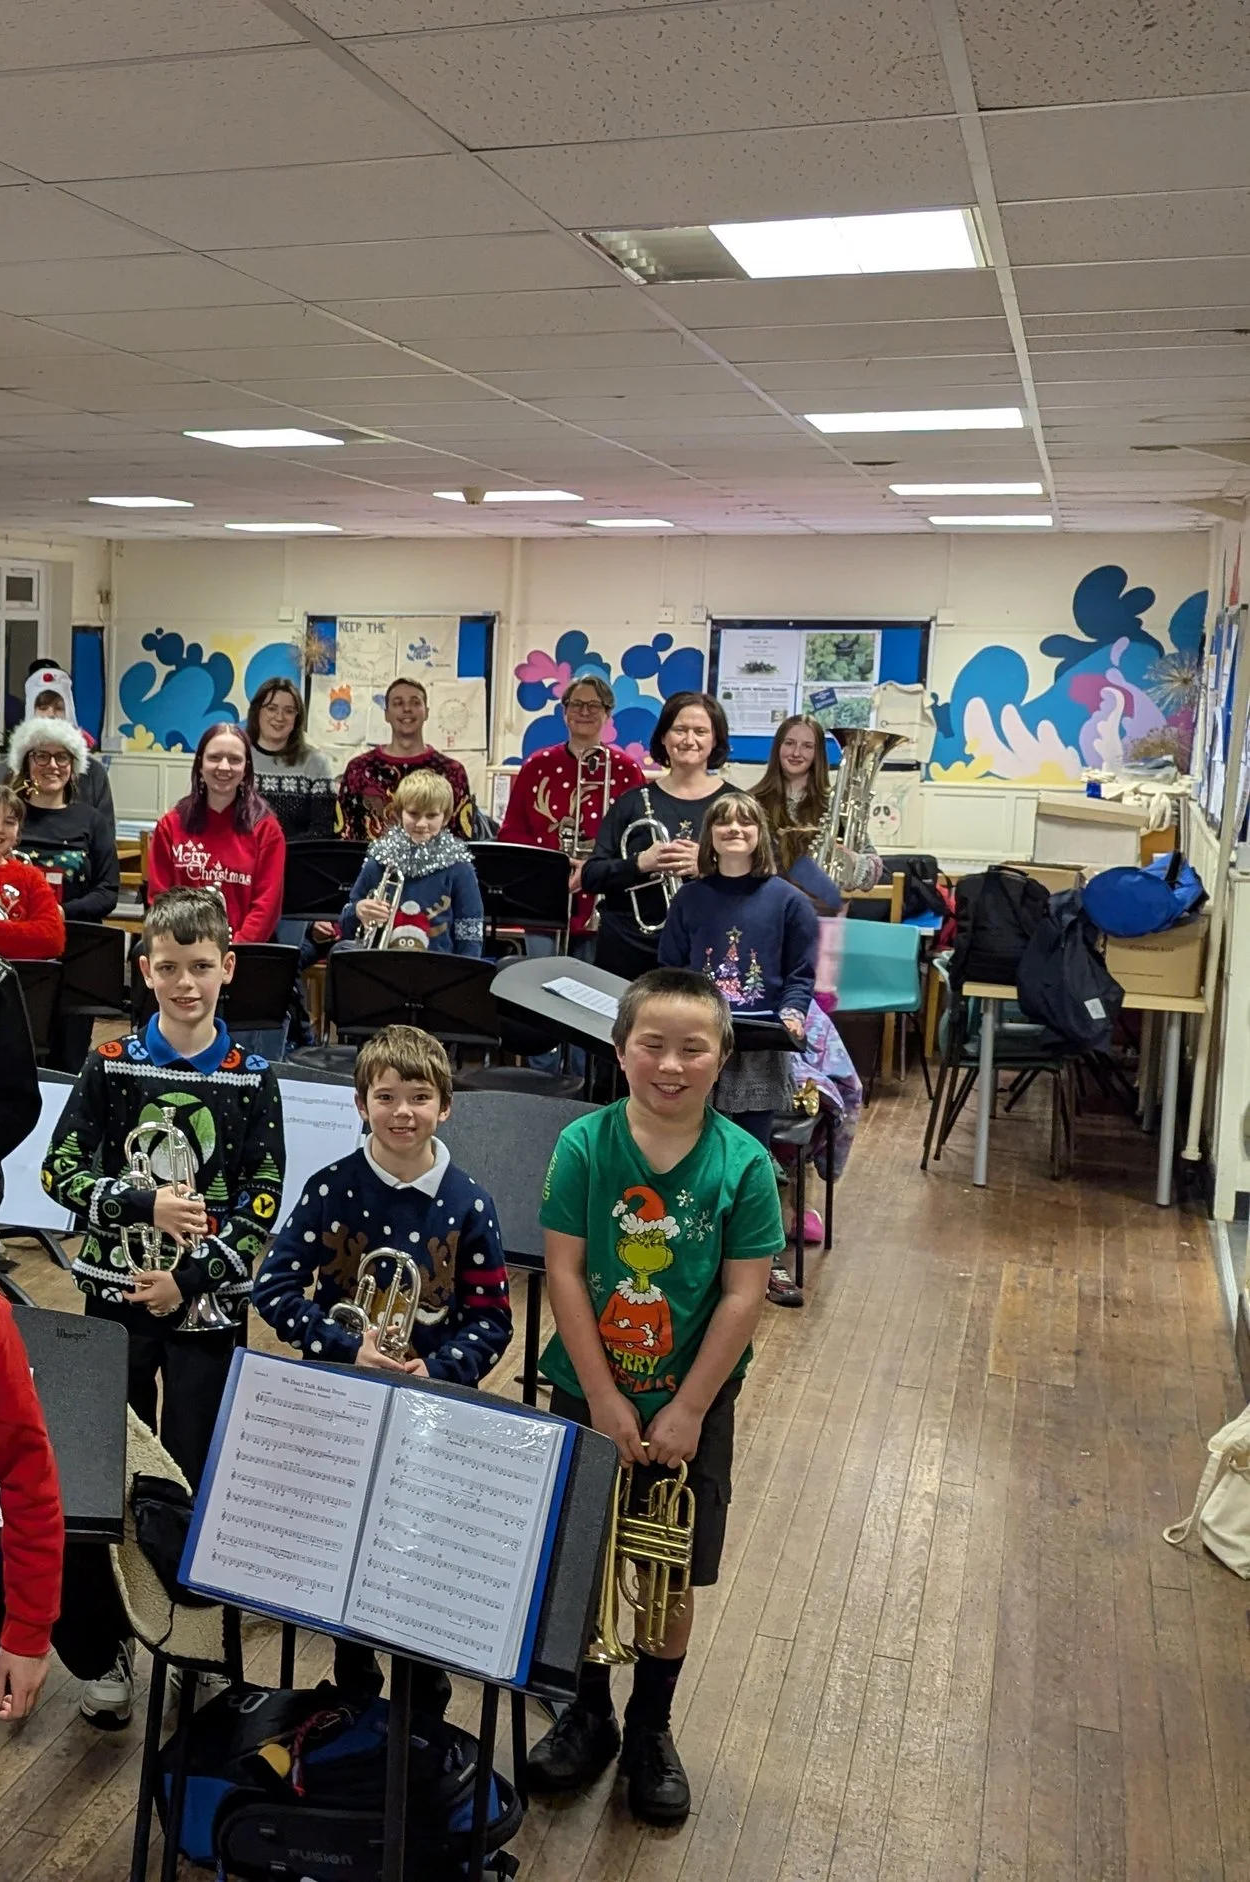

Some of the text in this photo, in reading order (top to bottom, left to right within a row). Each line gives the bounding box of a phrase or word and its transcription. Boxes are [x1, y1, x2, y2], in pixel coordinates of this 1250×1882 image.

[339, 621, 386, 633] KEEP THE
[172, 843, 212, 867] Merry
[186, 861, 252, 886] Christmas
[613, 1348, 659, 1376] ERRY
